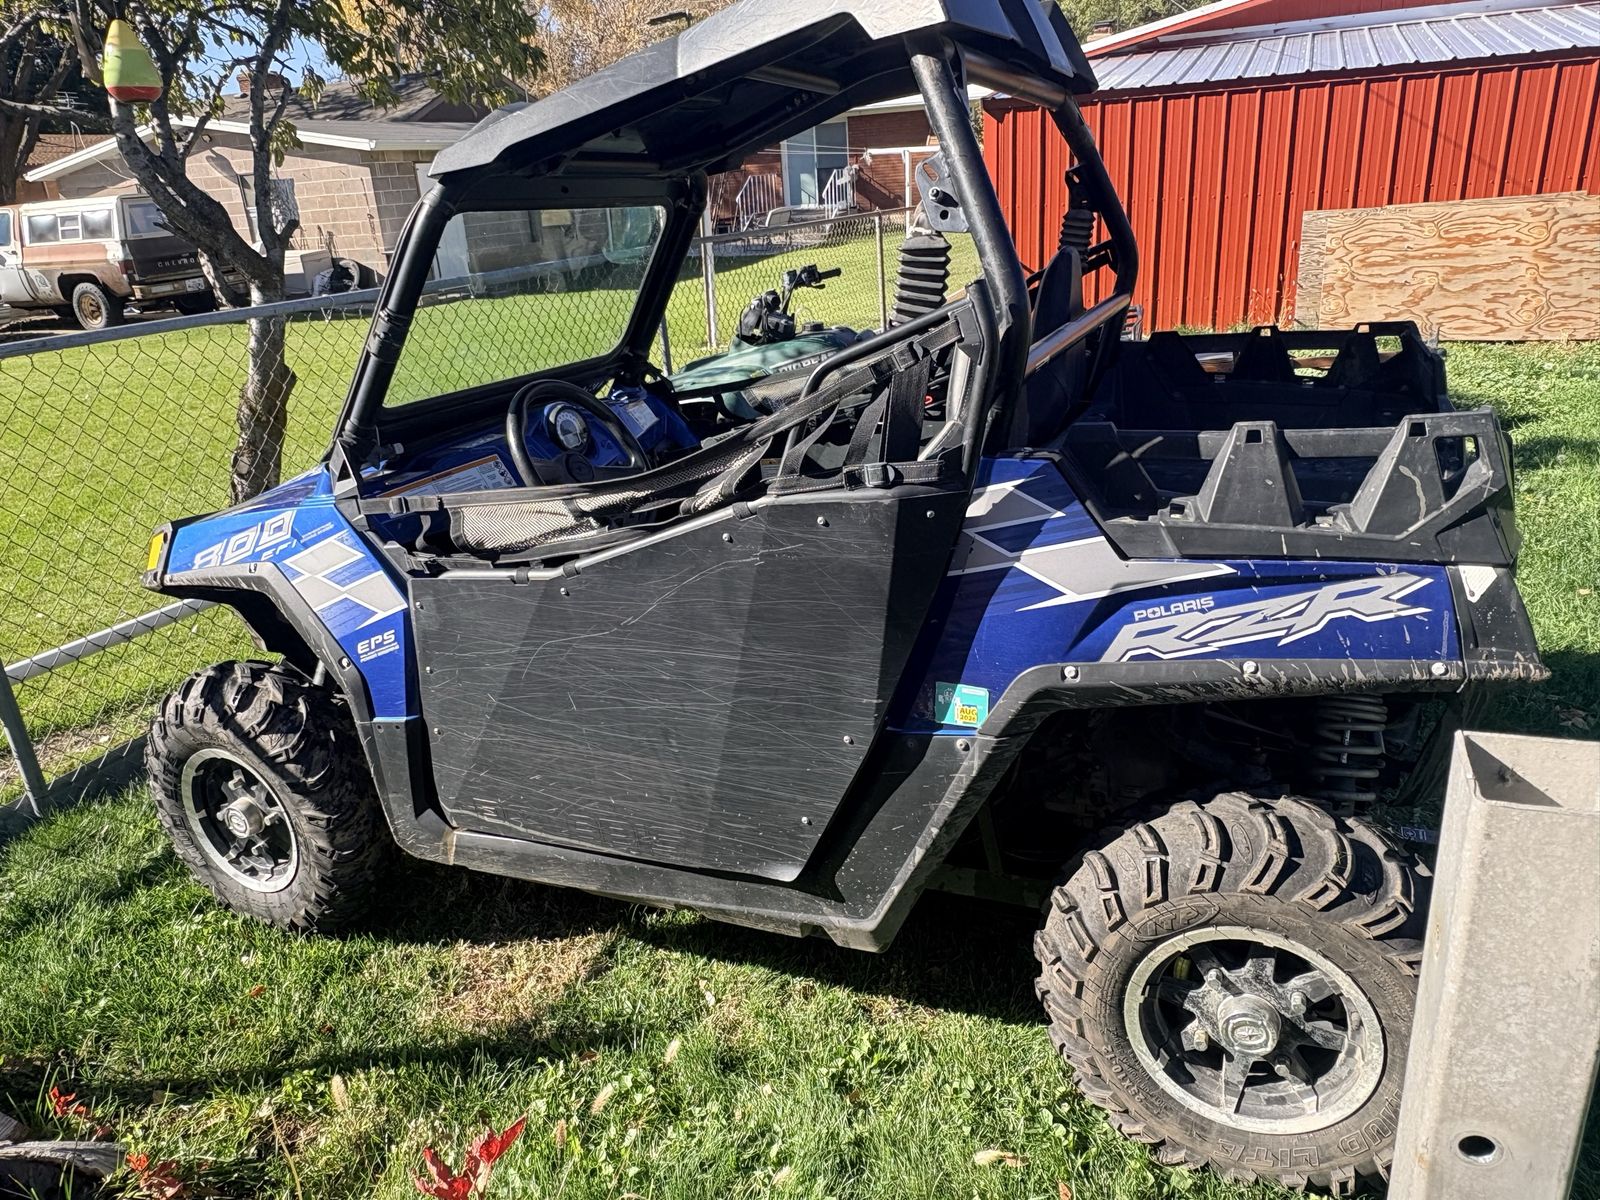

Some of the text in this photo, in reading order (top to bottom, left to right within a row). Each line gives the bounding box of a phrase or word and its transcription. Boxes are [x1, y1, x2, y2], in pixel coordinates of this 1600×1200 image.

[192, 510, 297, 570] 800
[260, 538, 297, 561] EFI
[1098, 571, 1434, 663] RZR
[1133, 596, 1215, 622] POLARIS
[357, 629, 396, 654] EPS
[960, 707, 977, 715] AUG
[1102, 1044, 1145, 1103] 25X10-12
[1212, 1138, 1320, 1168] LITE
